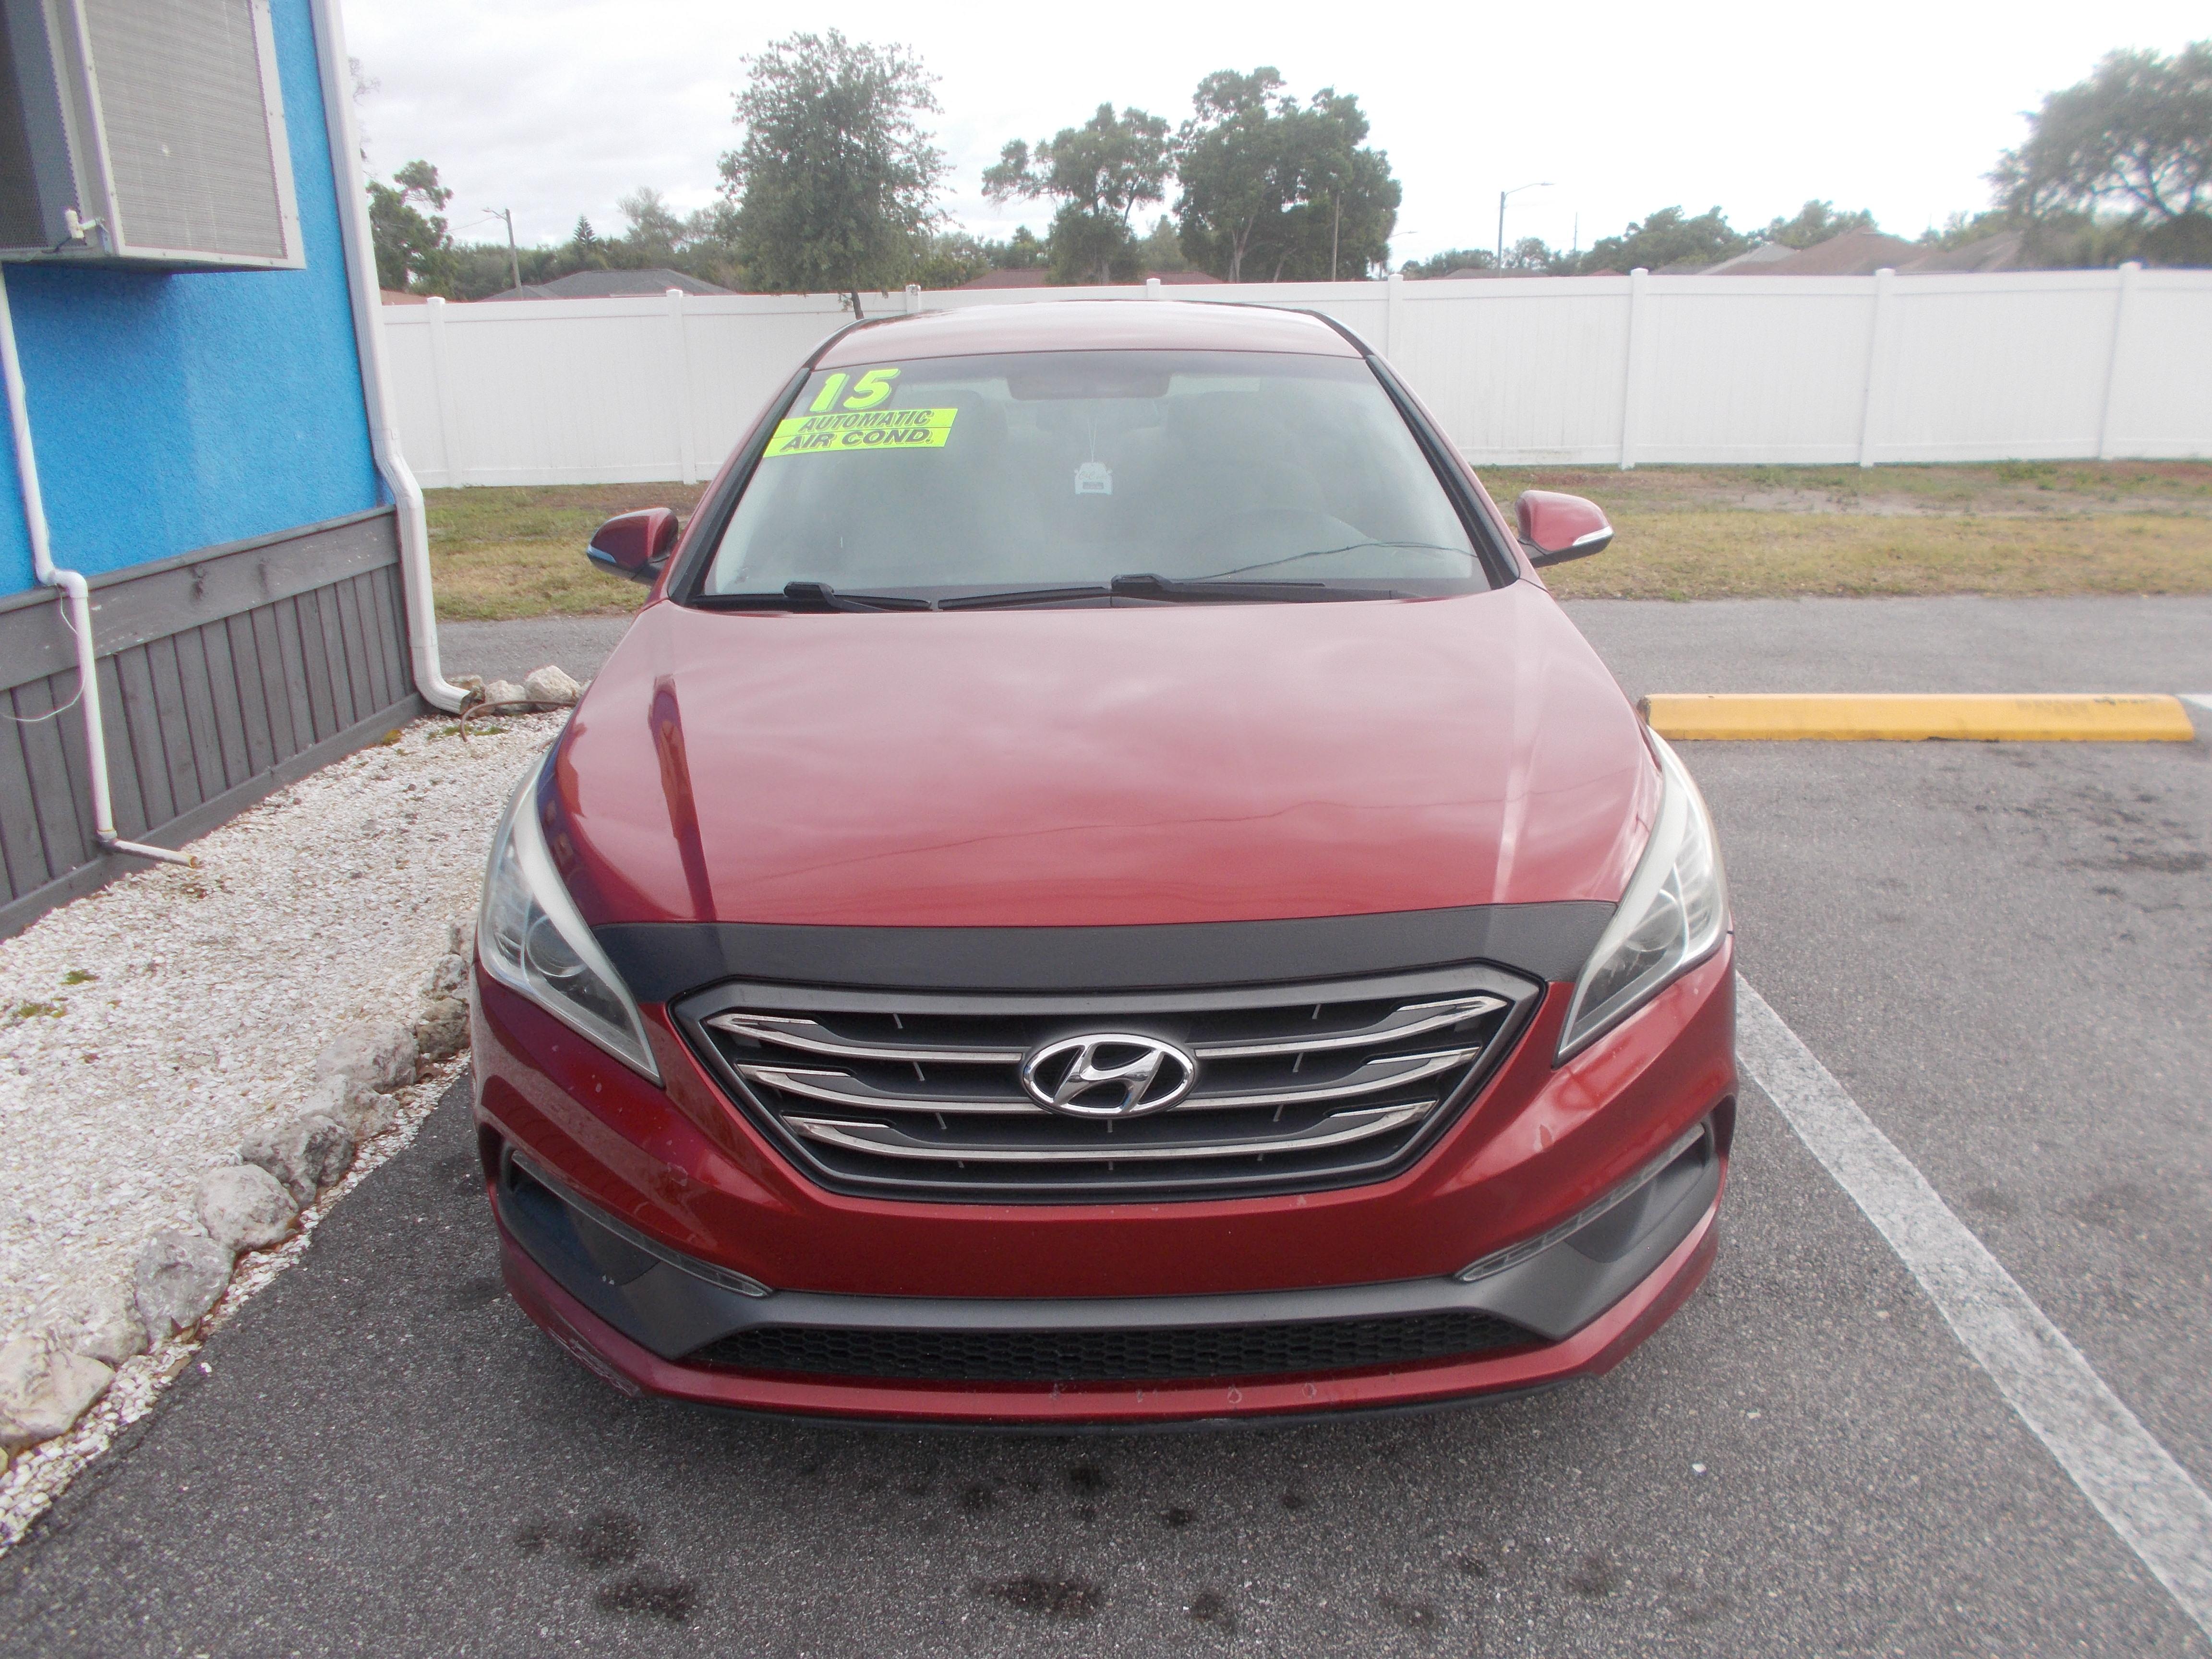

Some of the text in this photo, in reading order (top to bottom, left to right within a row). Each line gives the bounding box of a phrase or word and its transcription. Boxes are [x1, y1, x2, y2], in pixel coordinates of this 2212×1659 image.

[810, 369, 901, 412] 15
[798, 410, 934, 433] AUTOMATIC
[780, 429, 934, 452] AIR COND.
